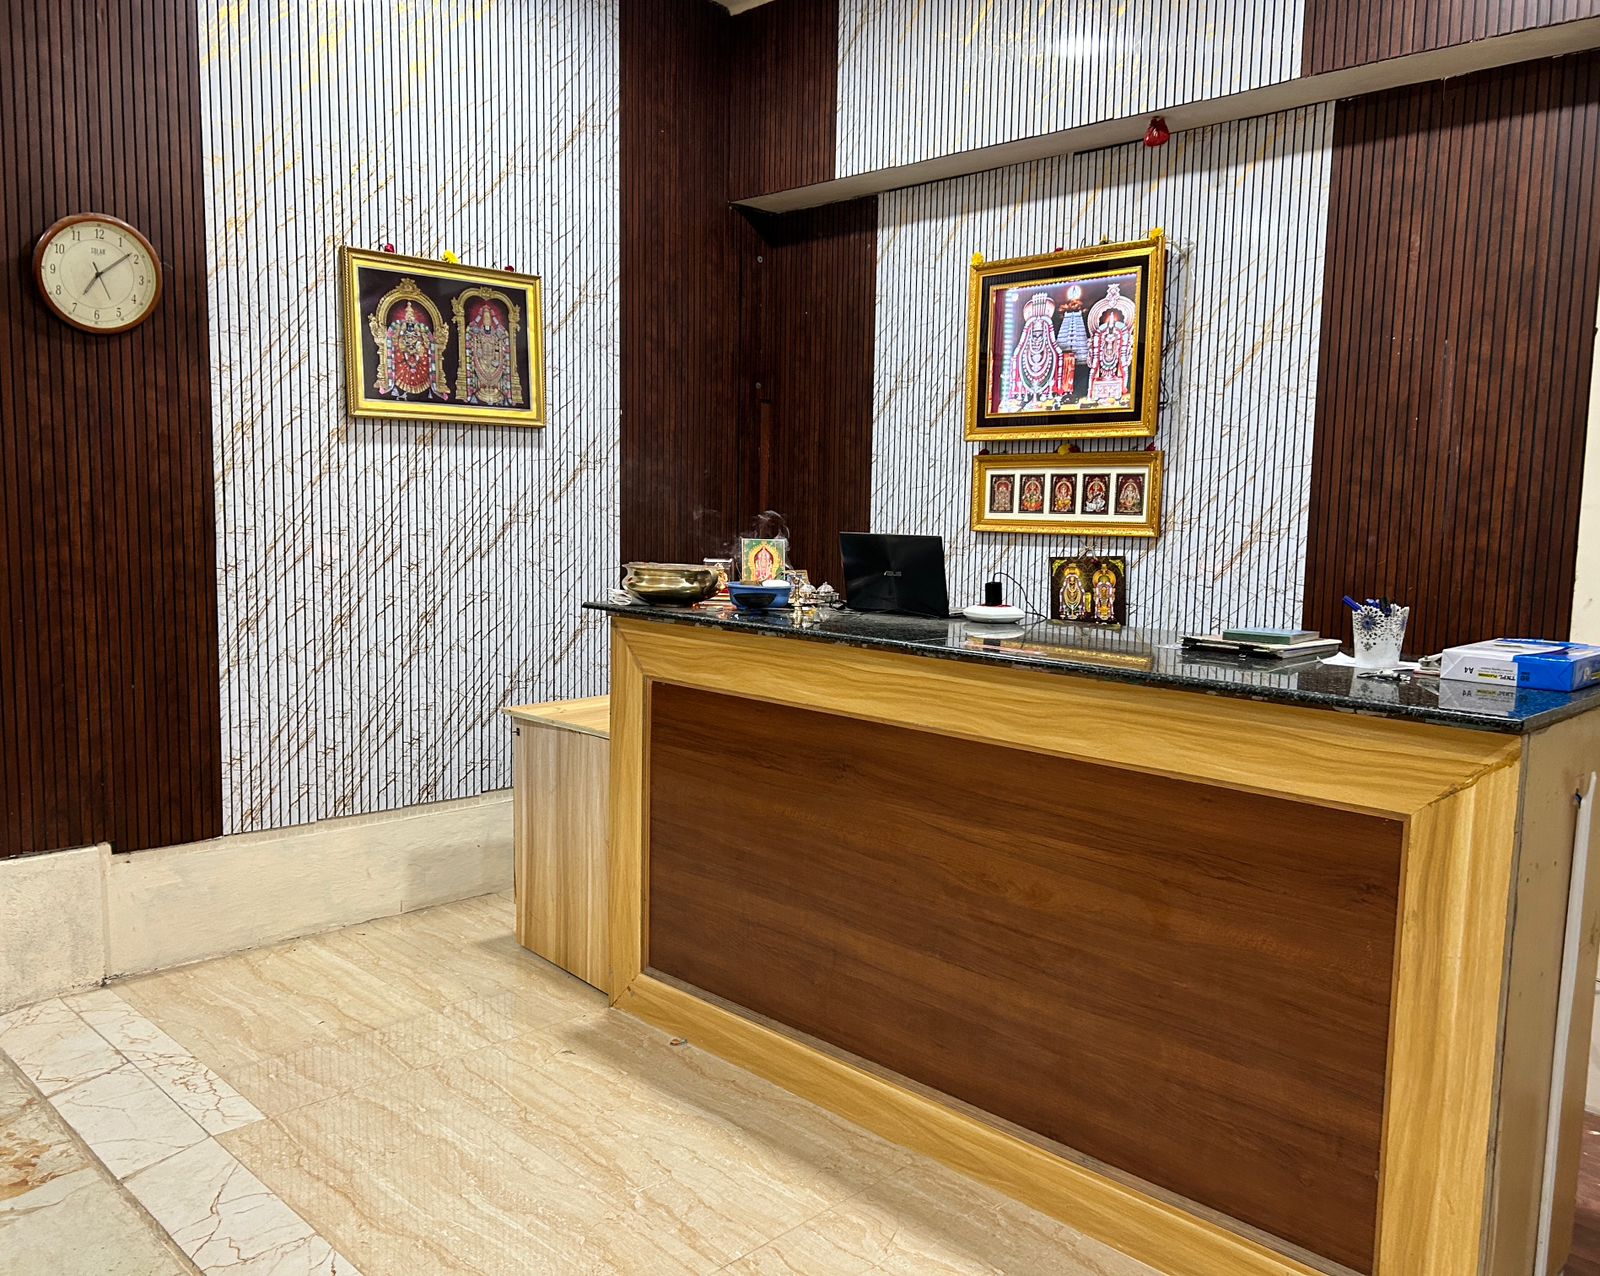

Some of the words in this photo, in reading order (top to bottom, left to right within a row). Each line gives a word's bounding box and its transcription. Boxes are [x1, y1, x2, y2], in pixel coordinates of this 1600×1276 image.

[72, 230, 80, 241] 11
[95, 229, 104, 239] 12
[55, 244, 64, 254] 10
[133, 254, 139, 264] 2
[50, 264, 55, 273] 9
[139, 276, 144, 285] 3
[56, 285, 61, 295] 8
[131, 294, 136, 304] 4
[72, 303, 77, 312] 7
[116, 308, 121, 317] 5
[94, 310, 99, 320] 6
